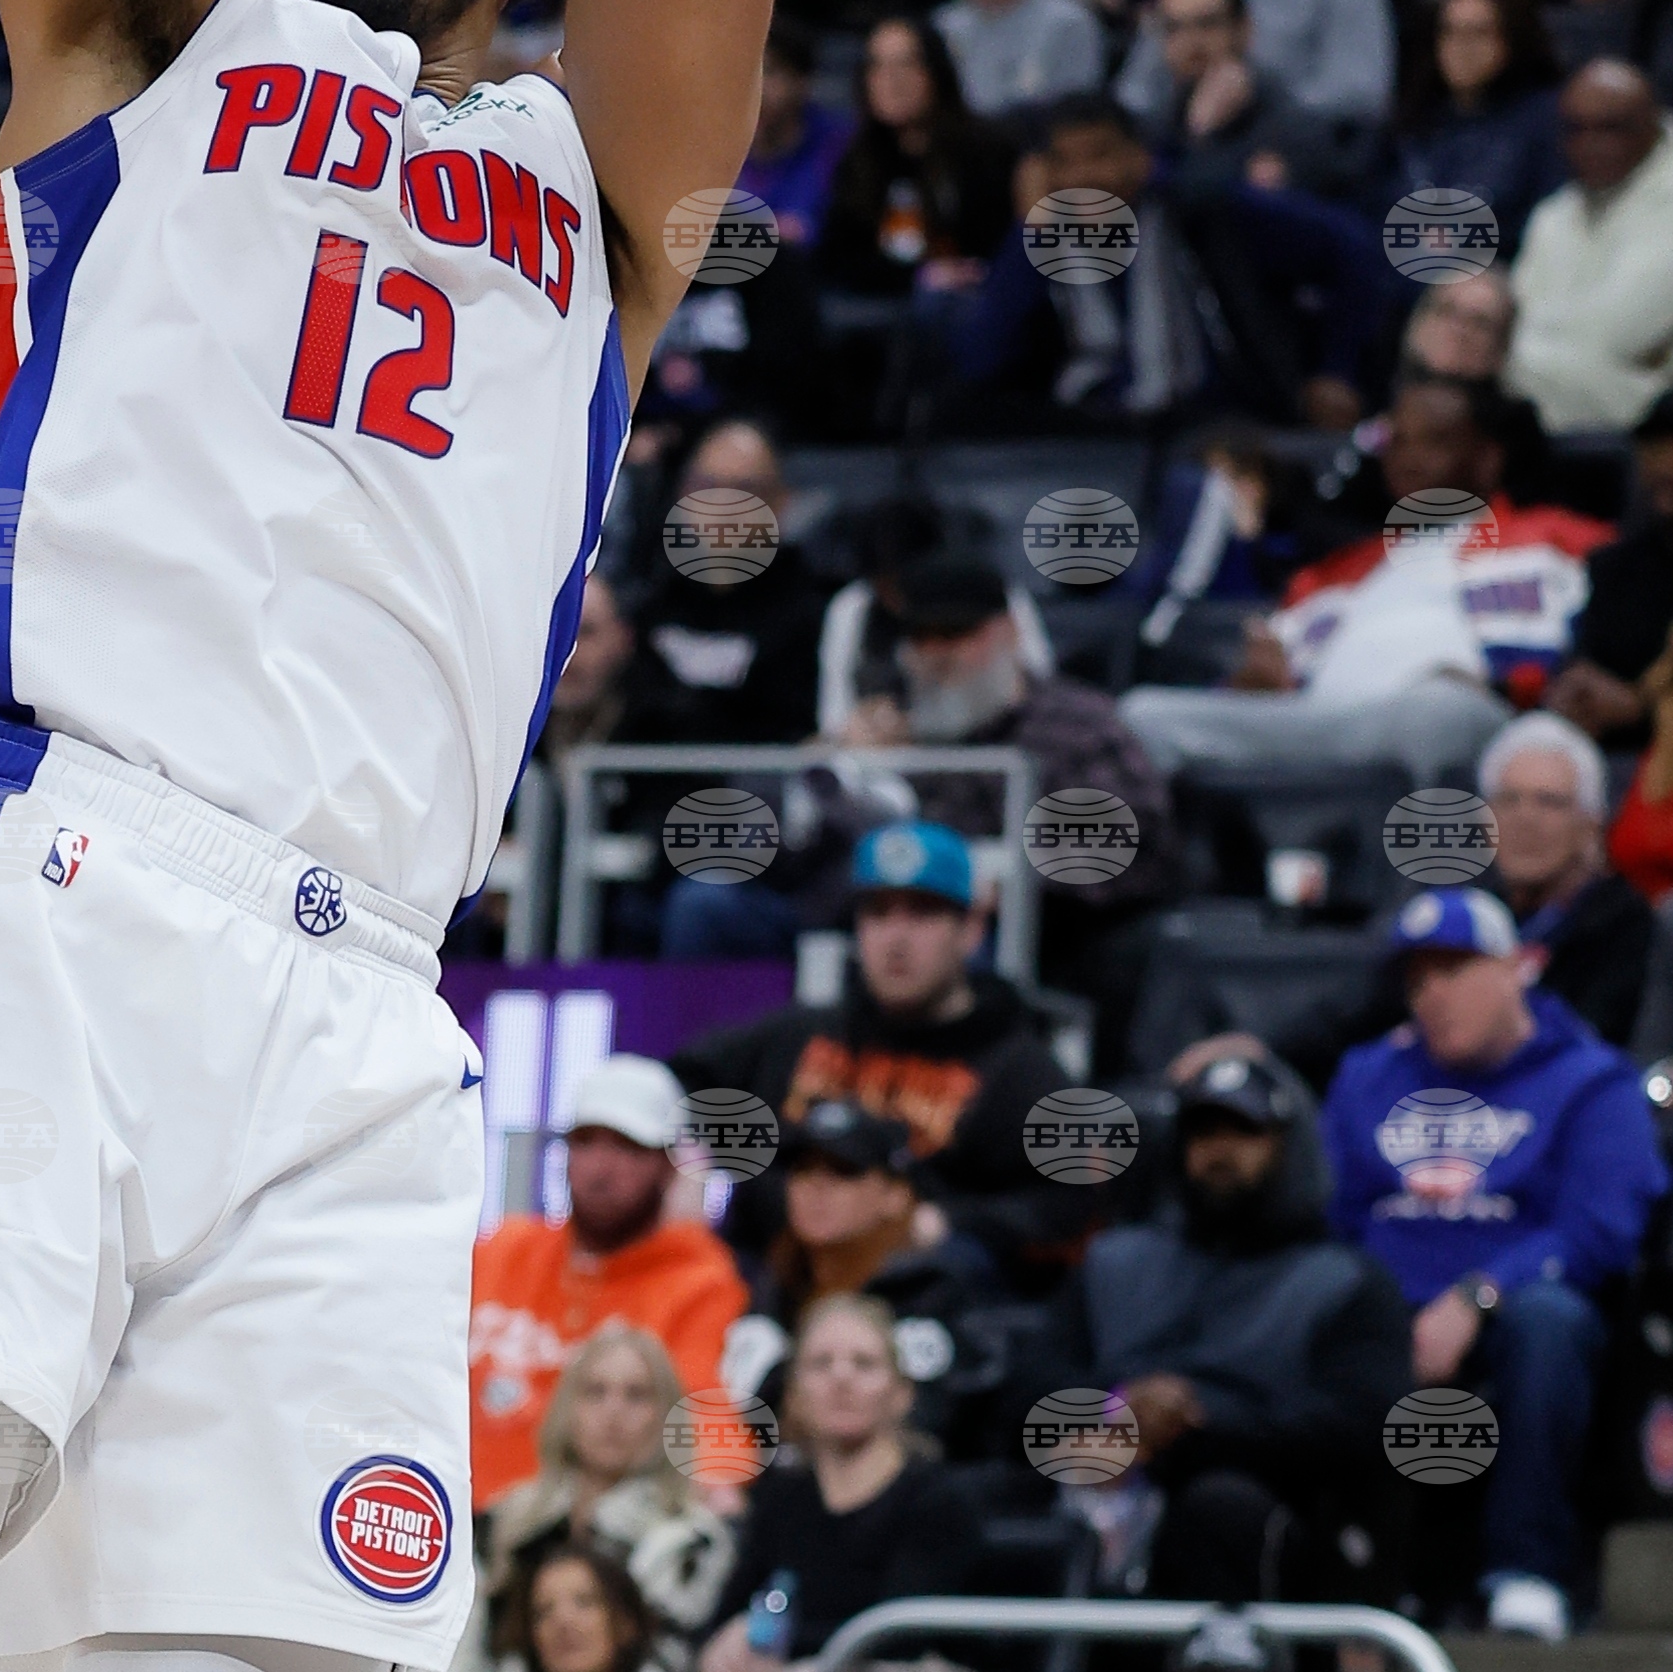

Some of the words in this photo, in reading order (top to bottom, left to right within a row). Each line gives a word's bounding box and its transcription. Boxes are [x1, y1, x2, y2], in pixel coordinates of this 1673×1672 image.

[203, 63, 581, 318] PISONS
[282, 227, 455, 459] 12
[350, 1520, 432, 1563] PISTONS
[353, 1496, 434, 1538] DETROIT
